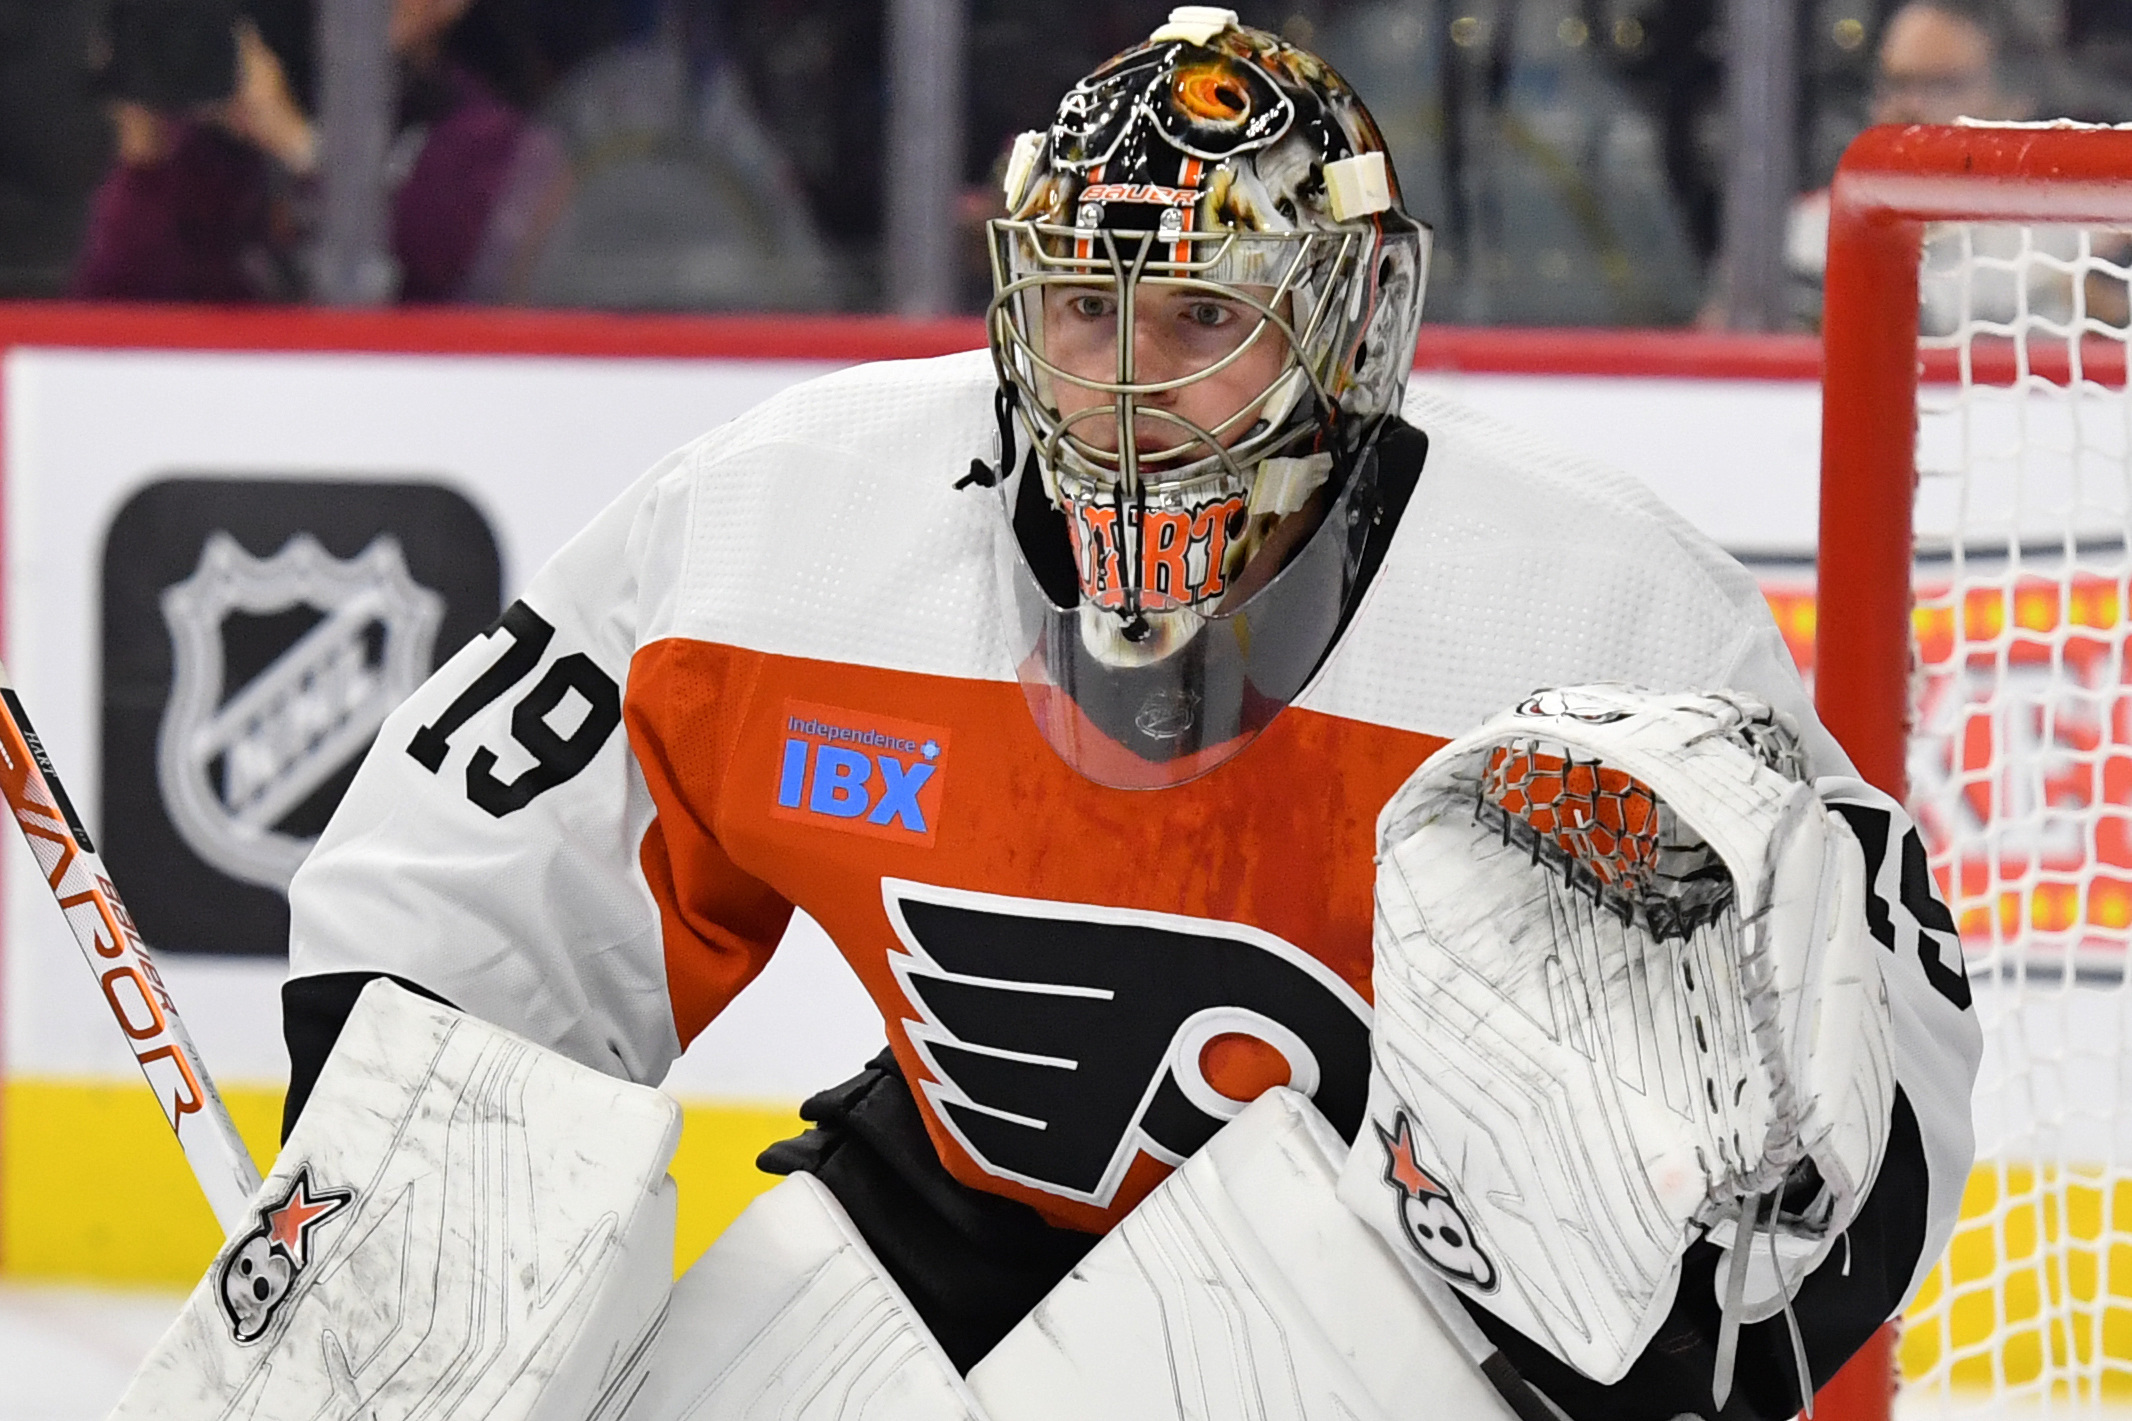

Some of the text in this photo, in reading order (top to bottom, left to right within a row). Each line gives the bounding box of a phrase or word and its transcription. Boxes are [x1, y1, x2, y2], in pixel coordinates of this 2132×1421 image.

[1079, 184, 1198, 206] BAUER
[407, 599, 621, 818] 79
[788, 716, 916, 752] Independence
[778, 739, 937, 833] IBX
[95, 873, 179, 1017] BAUER
